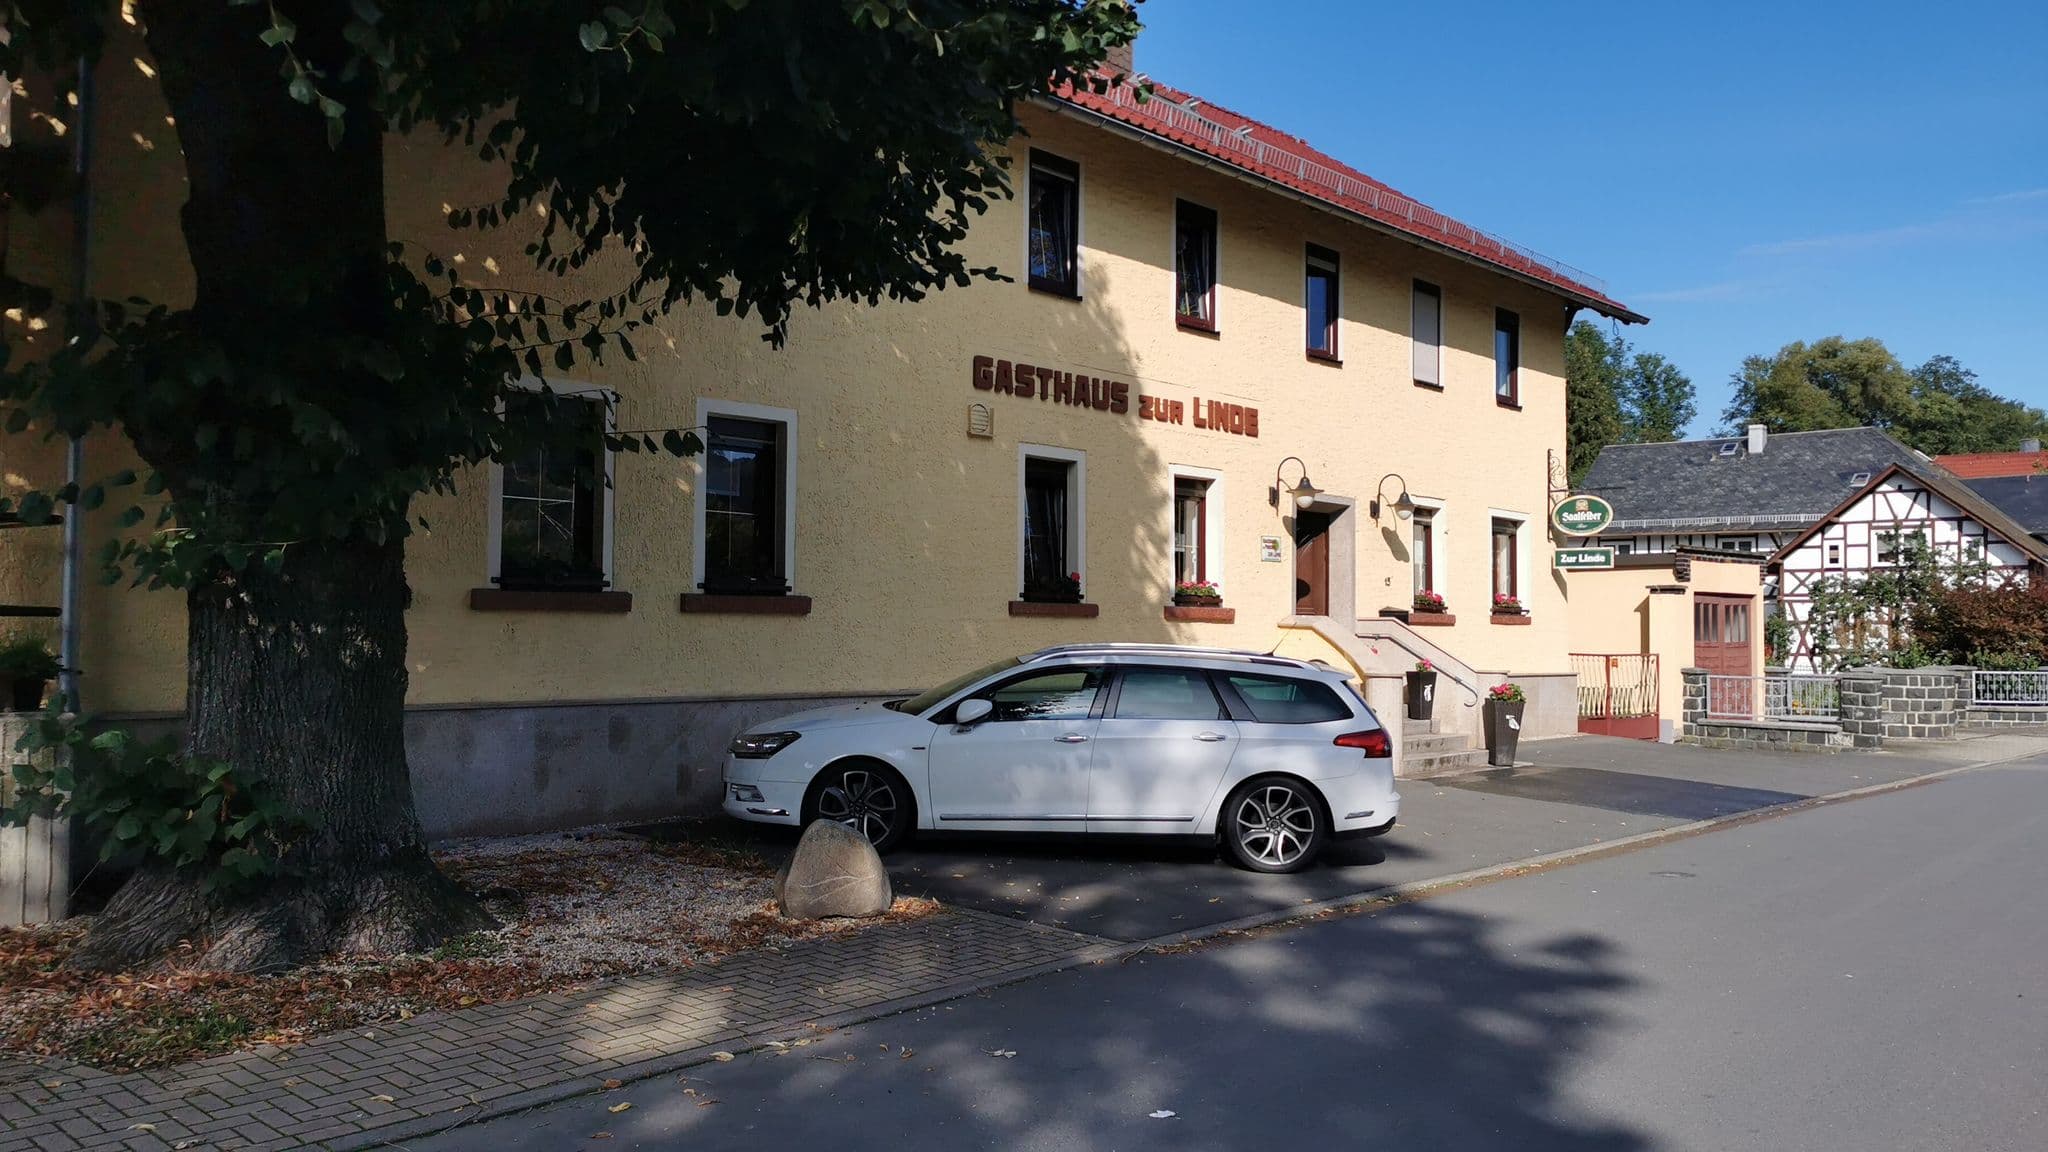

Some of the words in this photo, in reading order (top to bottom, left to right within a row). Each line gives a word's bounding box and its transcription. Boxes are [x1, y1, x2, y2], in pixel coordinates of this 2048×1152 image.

[972, 355, 1129, 415] GASTHAUS
[1138, 394, 1184, 425] ZUR
[1192, 397, 1260, 438] LINDE
[1561, 511, 1602, 522] Saalfelder
[1560, 553, 1577, 563] Zur
[1578, 553, 1606, 563] Linde
